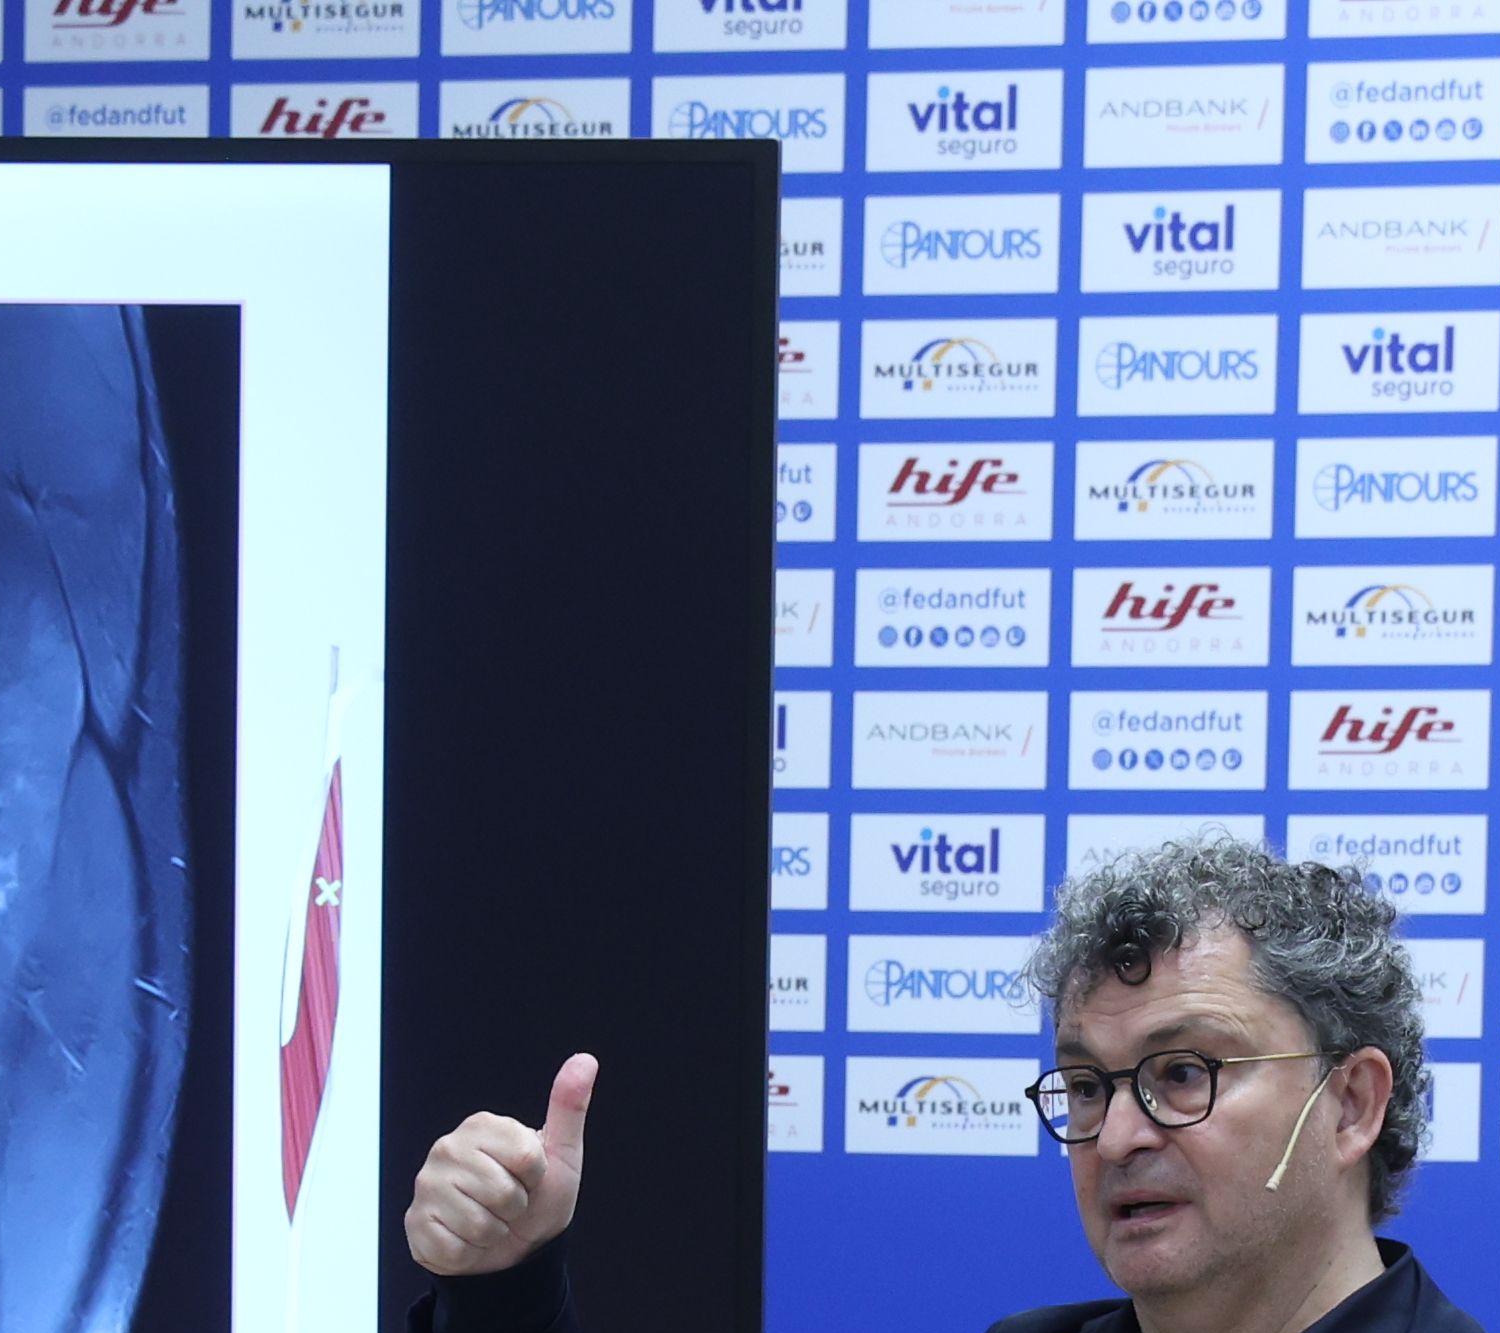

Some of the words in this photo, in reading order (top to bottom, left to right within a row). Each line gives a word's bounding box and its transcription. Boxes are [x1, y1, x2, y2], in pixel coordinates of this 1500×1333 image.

[244, 2, 405, 21] MULTISEGUR
[723, 16, 804, 40] seguro
[1328, 76, 1483, 108] @fedandfut
[45, 103, 187, 129] @fedandfut
[259, 97, 395, 138] hife
[687, 101, 828, 140] PANTOURS
[907, 82, 1018, 134] vital
[1097, 96, 1248, 121] ANDBANK
[451, 121, 613, 139] MULTISEGUR
[936, 136, 1018, 160] seguro
[1122, 202, 1236, 255] vital
[1316, 217, 1469, 241] ANDBANK
[900, 217, 1042, 268] PANTOURS
[1152, 256, 1236, 281] seguro
[1340, 324, 1456, 376] vital
[875, 362, 1038, 379] MULTISEGUR
[1116, 338, 1260, 390] PANTOURS
[1370, 377, 1455, 402] seguro
[886, 455, 1026, 507] hife
[1088, 483, 1255, 500] MULTISEGUR
[1332, 459, 1479, 511] PANTOURS
[877, 586, 1027, 613] @fedandfut
[1101, 580, 1244, 633] hife
[1306, 609, 1474, 626] MULTISEGUR
[866, 721, 1012, 741] ANDBANK
[1091, 708, 1243, 735] @fedandfut
[1319, 702, 1463, 755] hife
[890, 826, 1000, 875] vital
[1309, 832, 1463, 859] @fedandfut
[918, 879, 1000, 902] seguro
[860, 1100, 1021, 1117] MULTISEGUR
